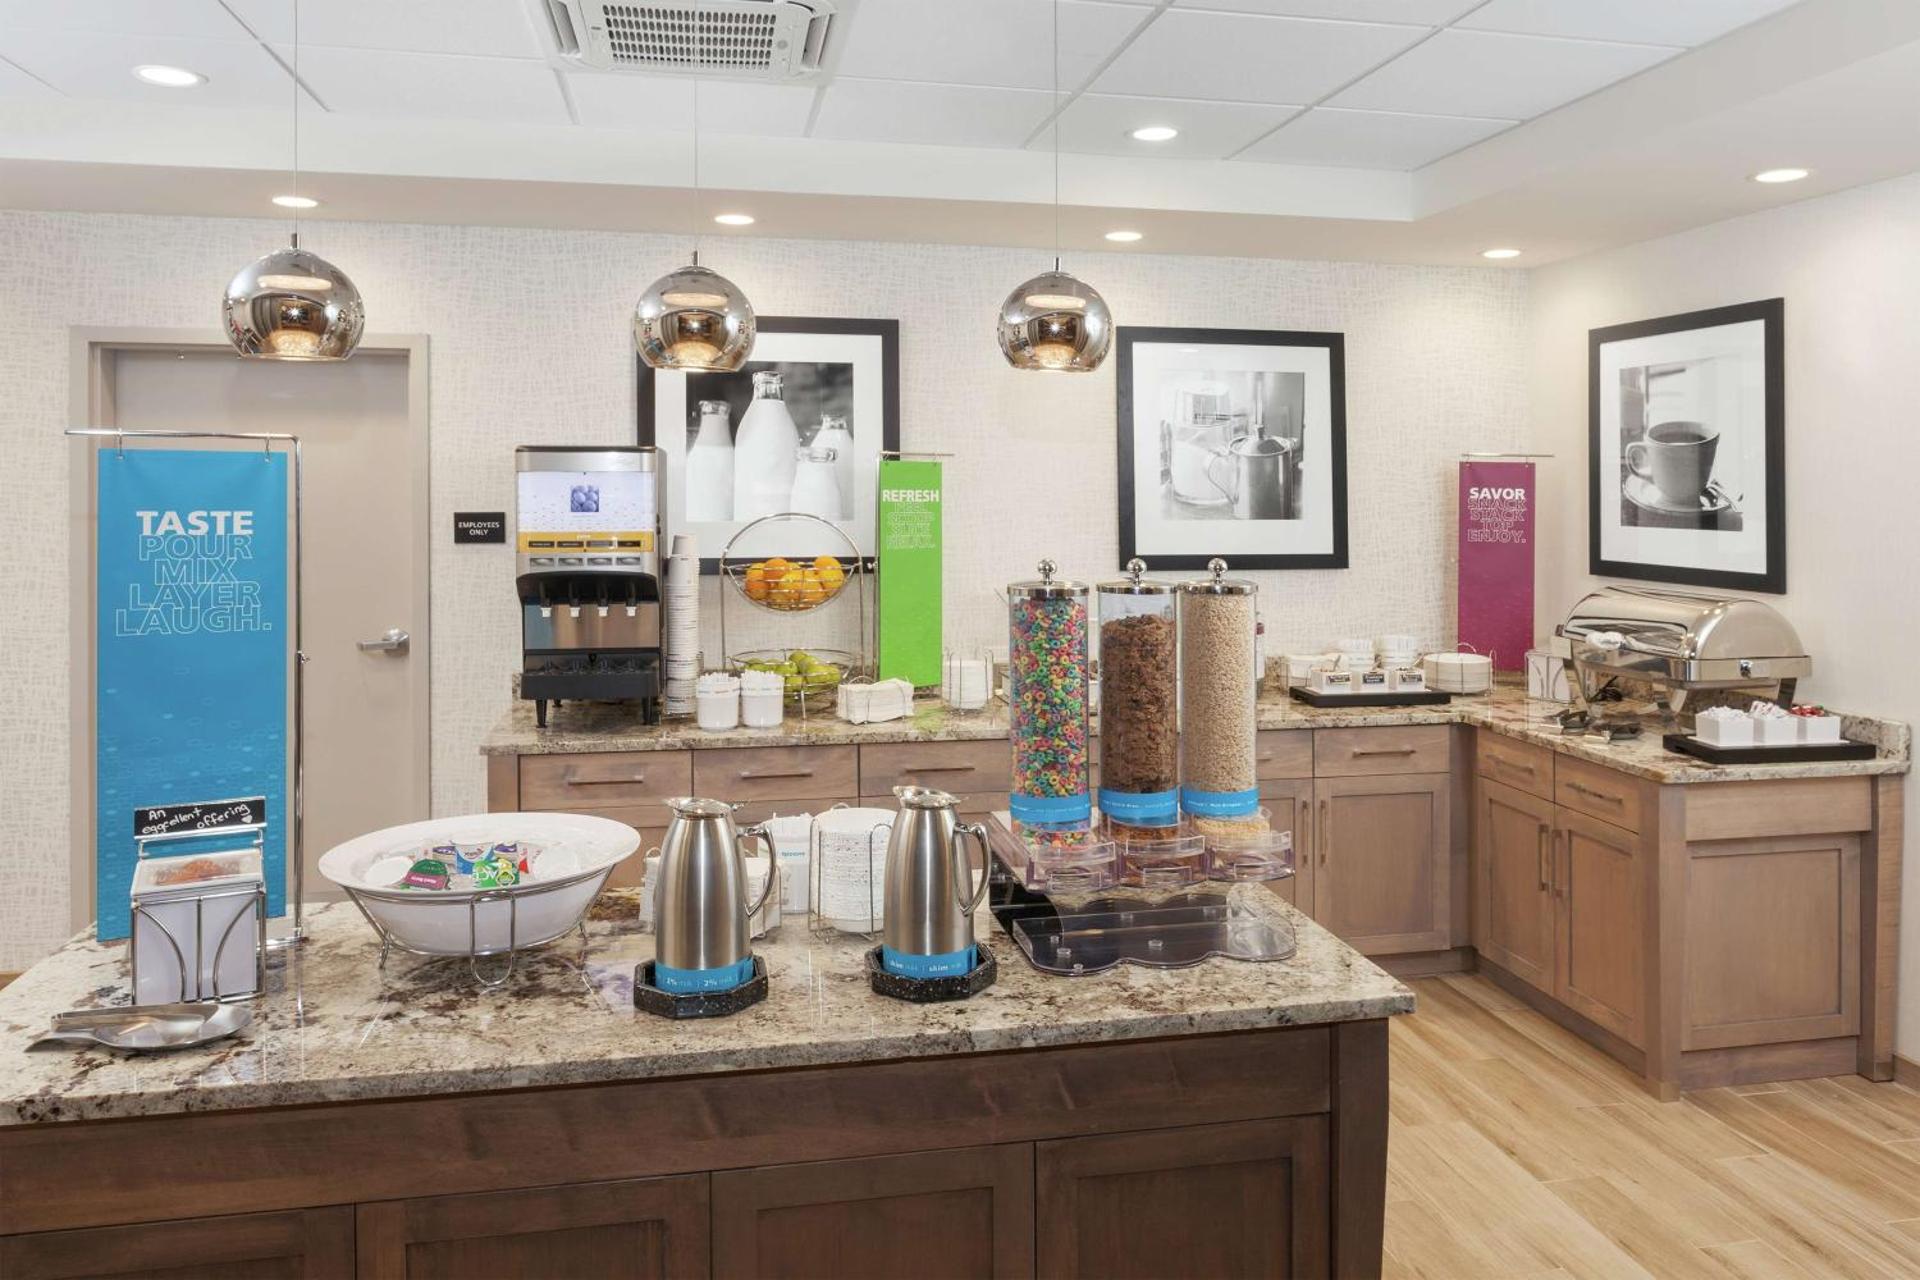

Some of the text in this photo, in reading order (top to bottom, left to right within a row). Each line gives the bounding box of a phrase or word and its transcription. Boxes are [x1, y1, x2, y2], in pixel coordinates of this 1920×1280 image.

[882, 489, 939, 502] REFRESH
[1467, 498, 1527, 511] SNACK
[1469, 487, 1526, 500] SAVOR
[136, 510, 253, 535] TASTE
[1470, 508, 1525, 521] STACK
[138, 534, 253, 561] POUR
[1467, 529, 1527, 543] ENJOY.
[154, 558, 238, 585] MIX
[129, 581, 262, 610] LAYER
[115, 606, 272, 636] LAUGH.
[141, 807, 203, 835] eggcellent
[148, 809, 166, 821] An
[196, 803, 251, 829] offering
